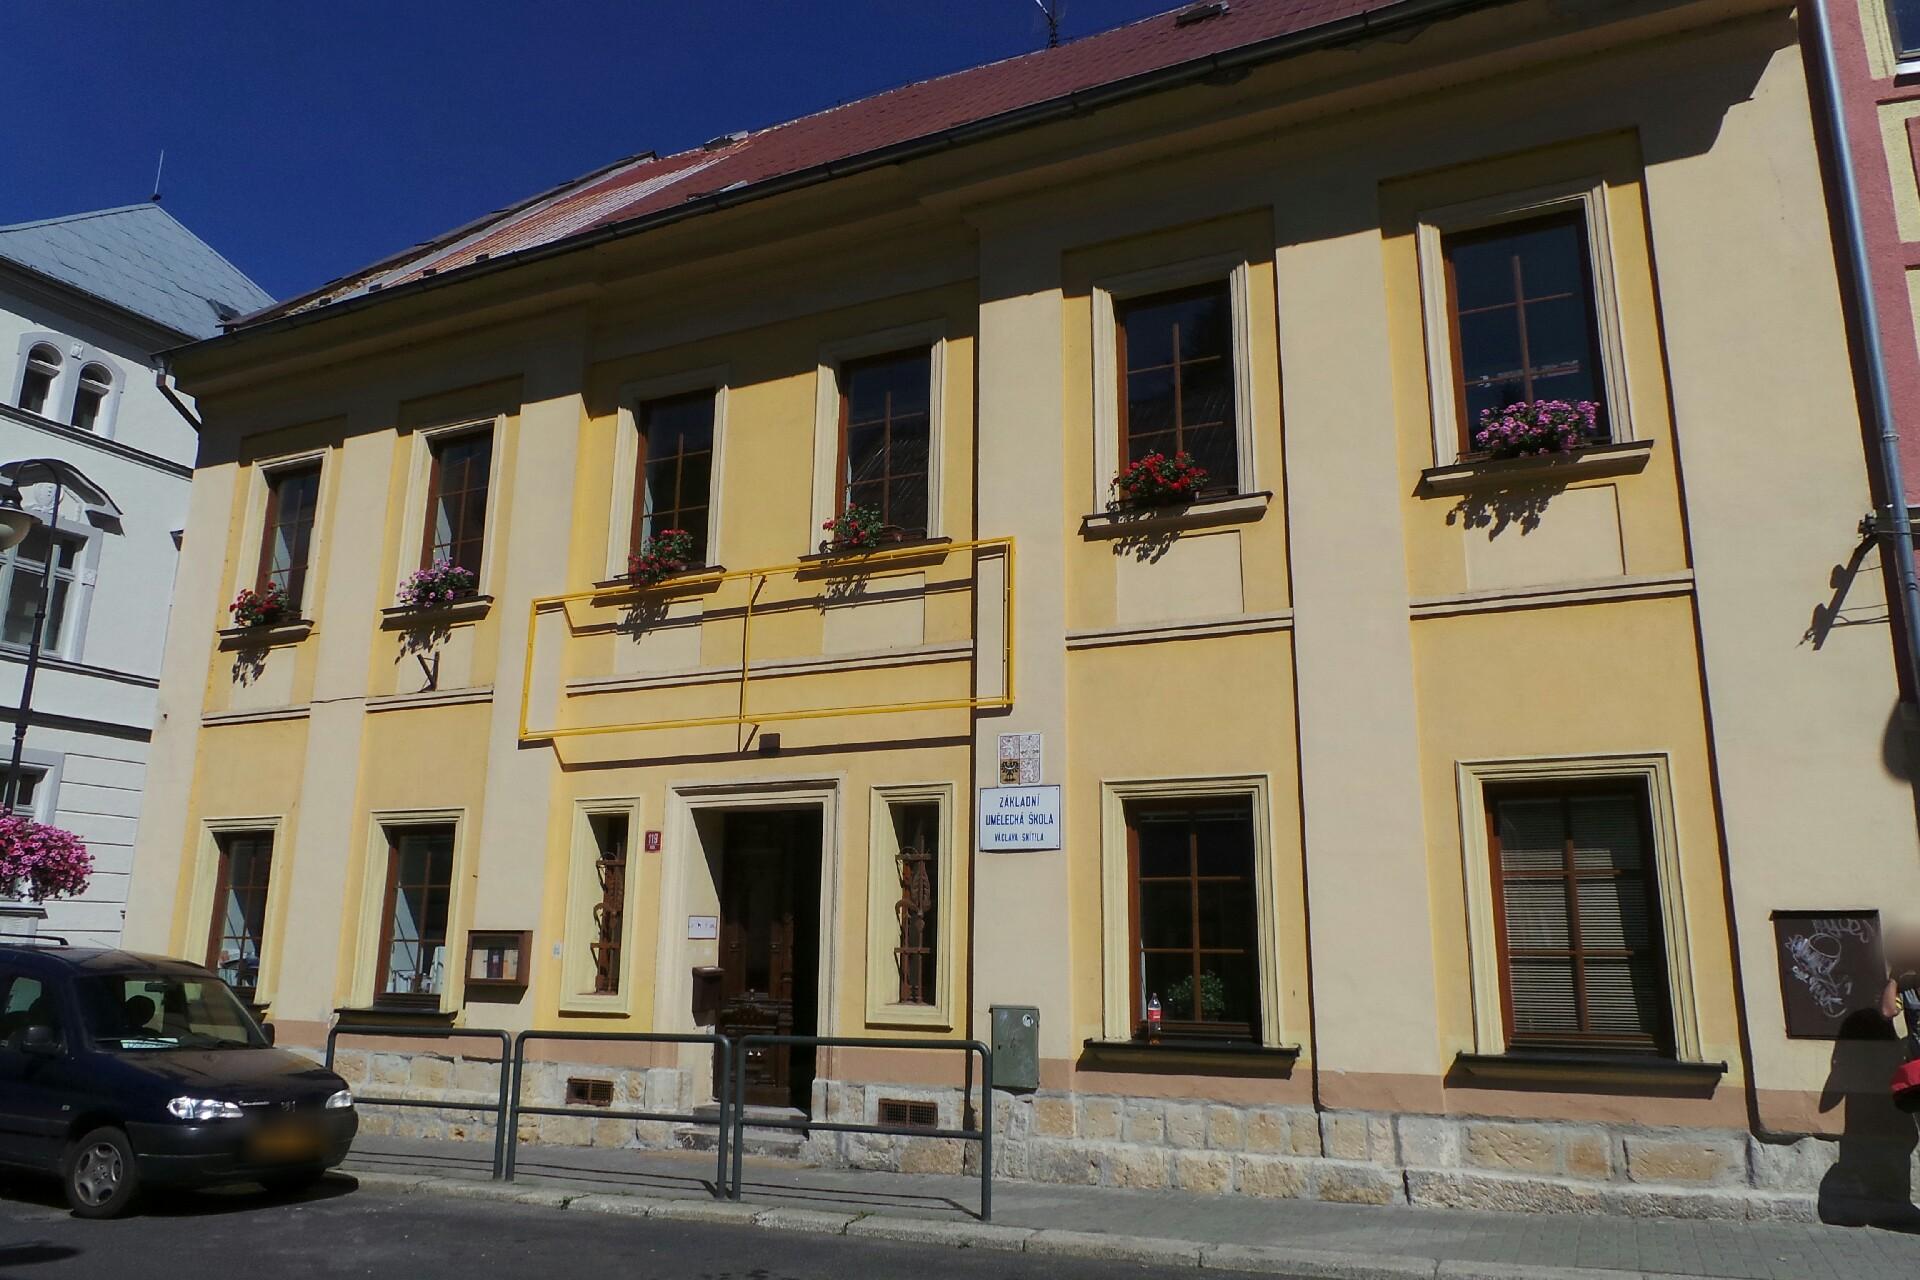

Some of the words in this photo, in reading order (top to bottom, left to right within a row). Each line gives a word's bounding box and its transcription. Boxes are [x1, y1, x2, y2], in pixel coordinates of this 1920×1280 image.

[999, 793, 1040, 808] ZÁKLADNÍ
[985, 812, 1024, 826] UMĚLECKÁ
[1028, 811, 1054, 825] ŠKOLA
